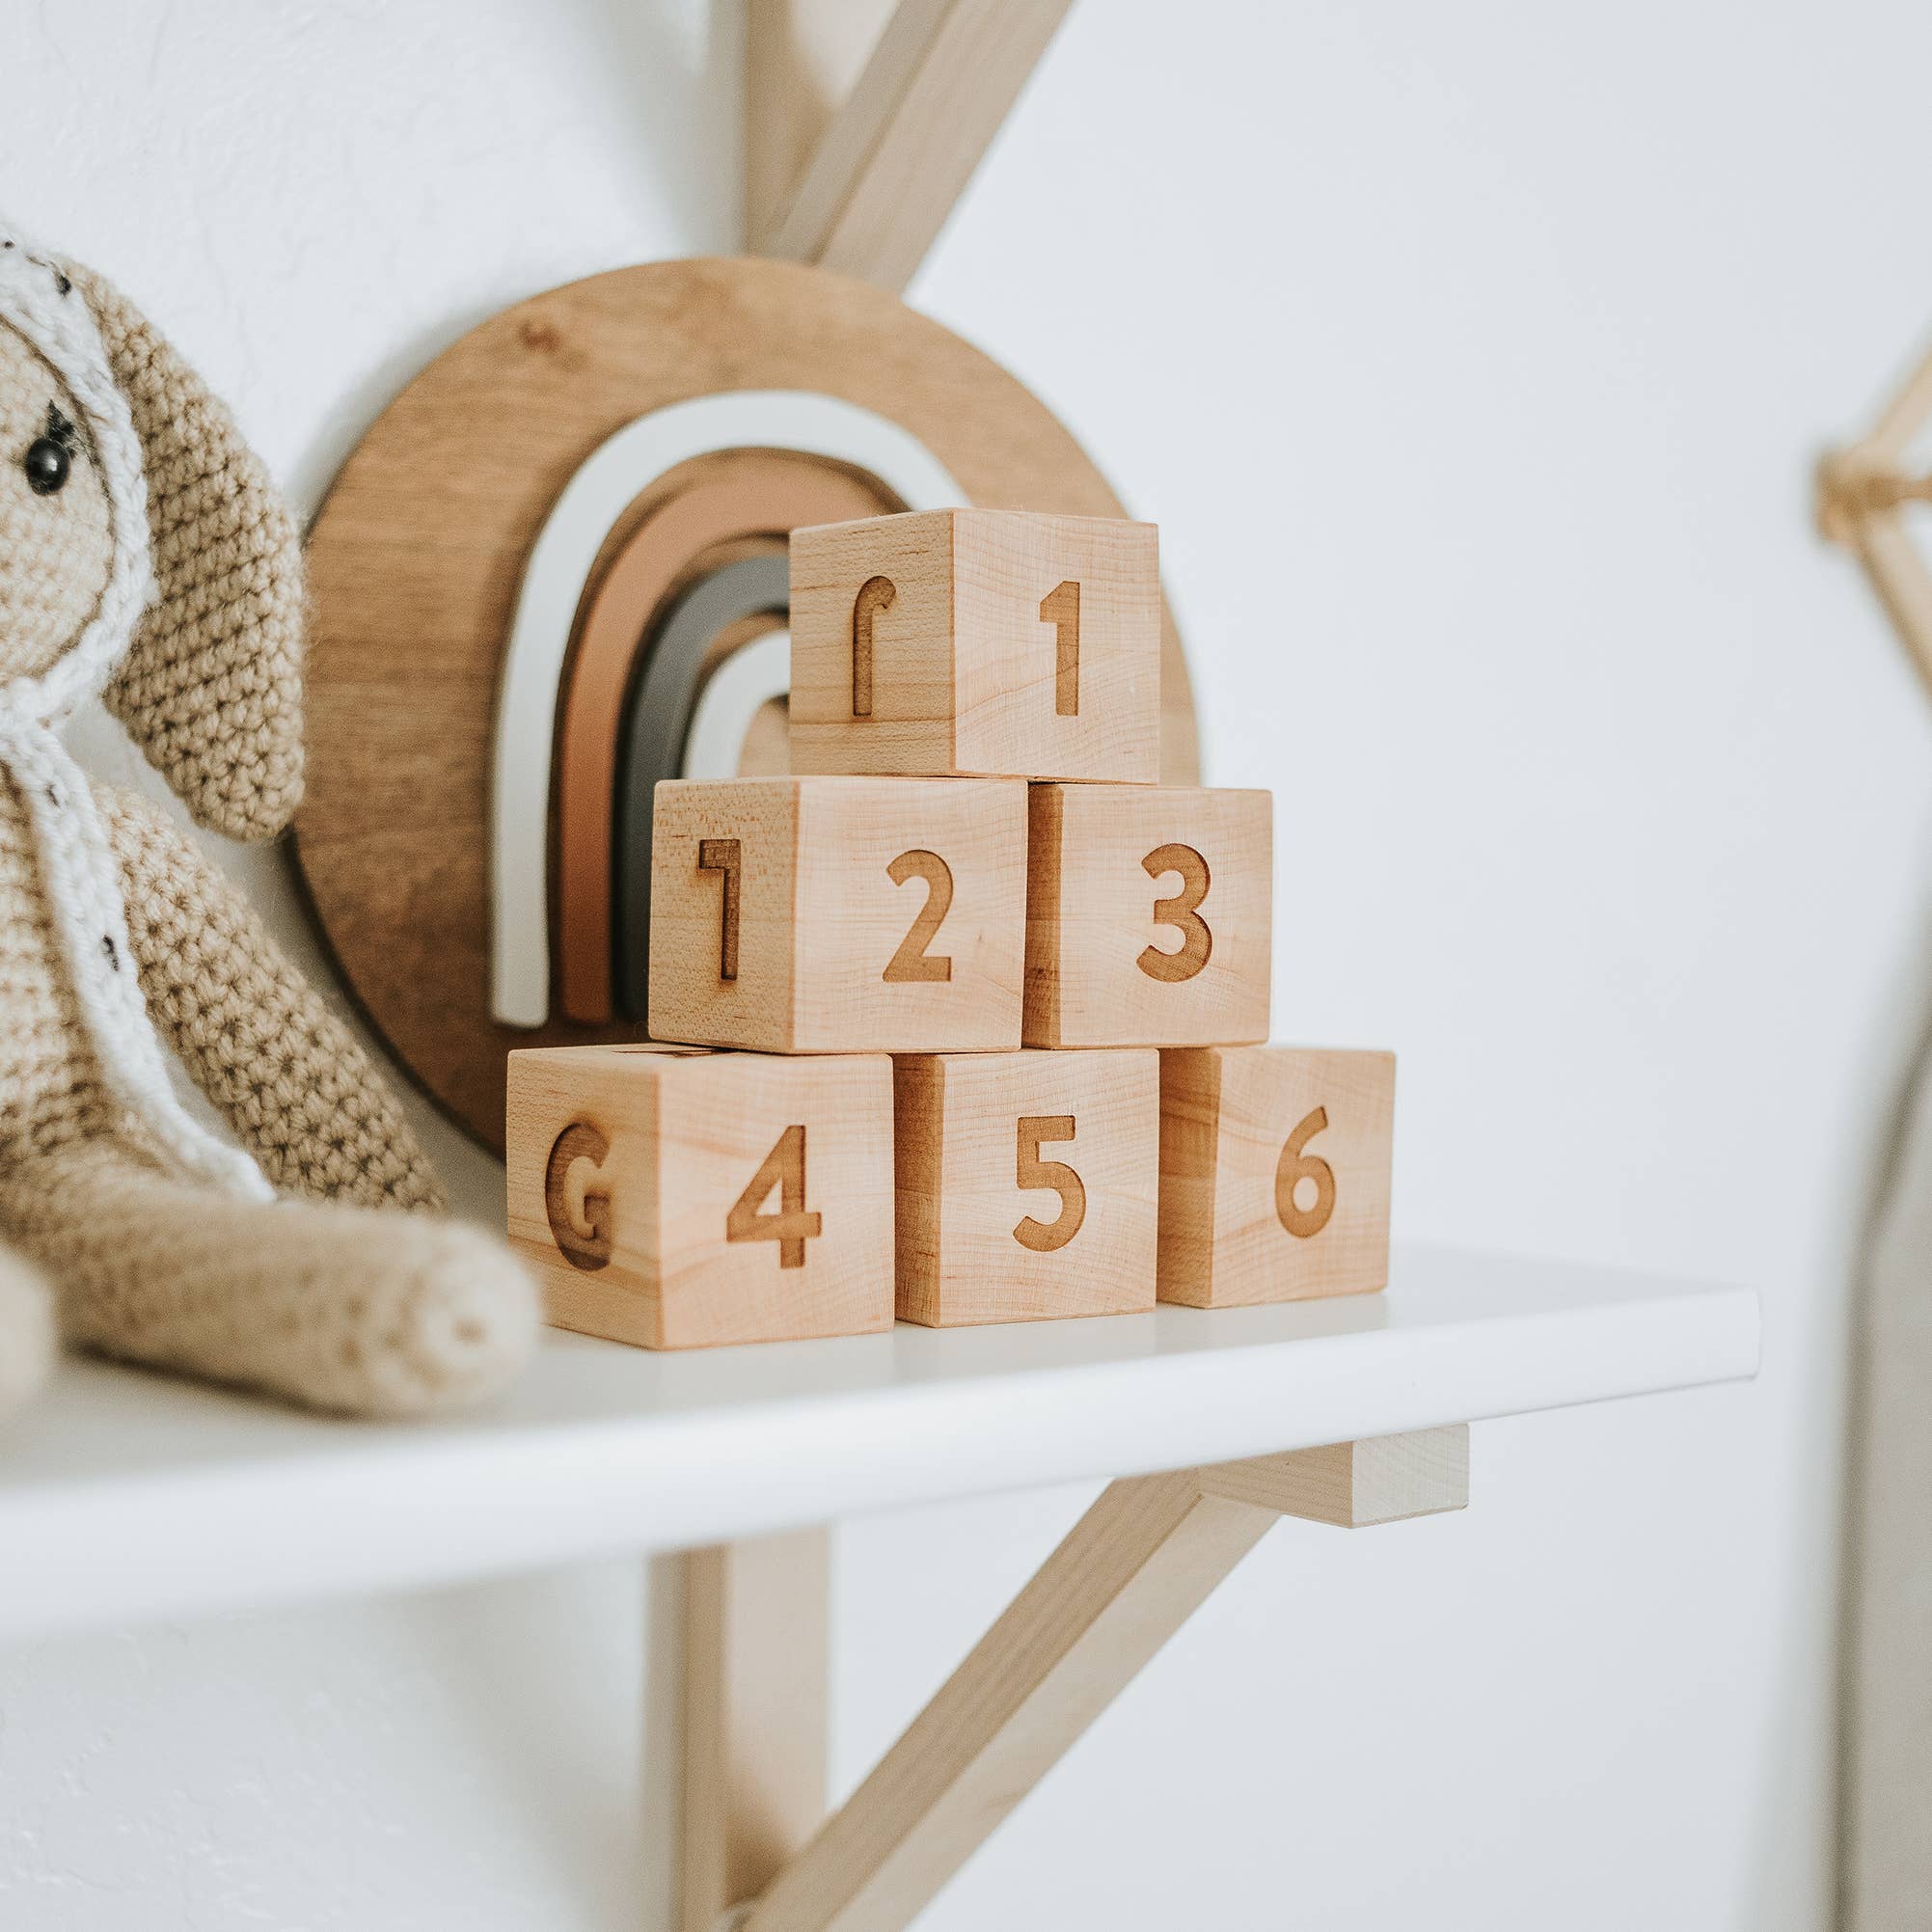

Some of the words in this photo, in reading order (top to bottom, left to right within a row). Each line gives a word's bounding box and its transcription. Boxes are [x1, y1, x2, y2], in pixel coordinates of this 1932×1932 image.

[1039, 581, 1080, 717] 1
[882, 849, 954, 983] 2
[1134, 843, 1213, 983] 3
[544, 1122, 611, 1271] G
[725, 1125, 822, 1269] 4
[1012, 1115, 1087, 1253] 5
[1274, 1105, 1336, 1239] 6
